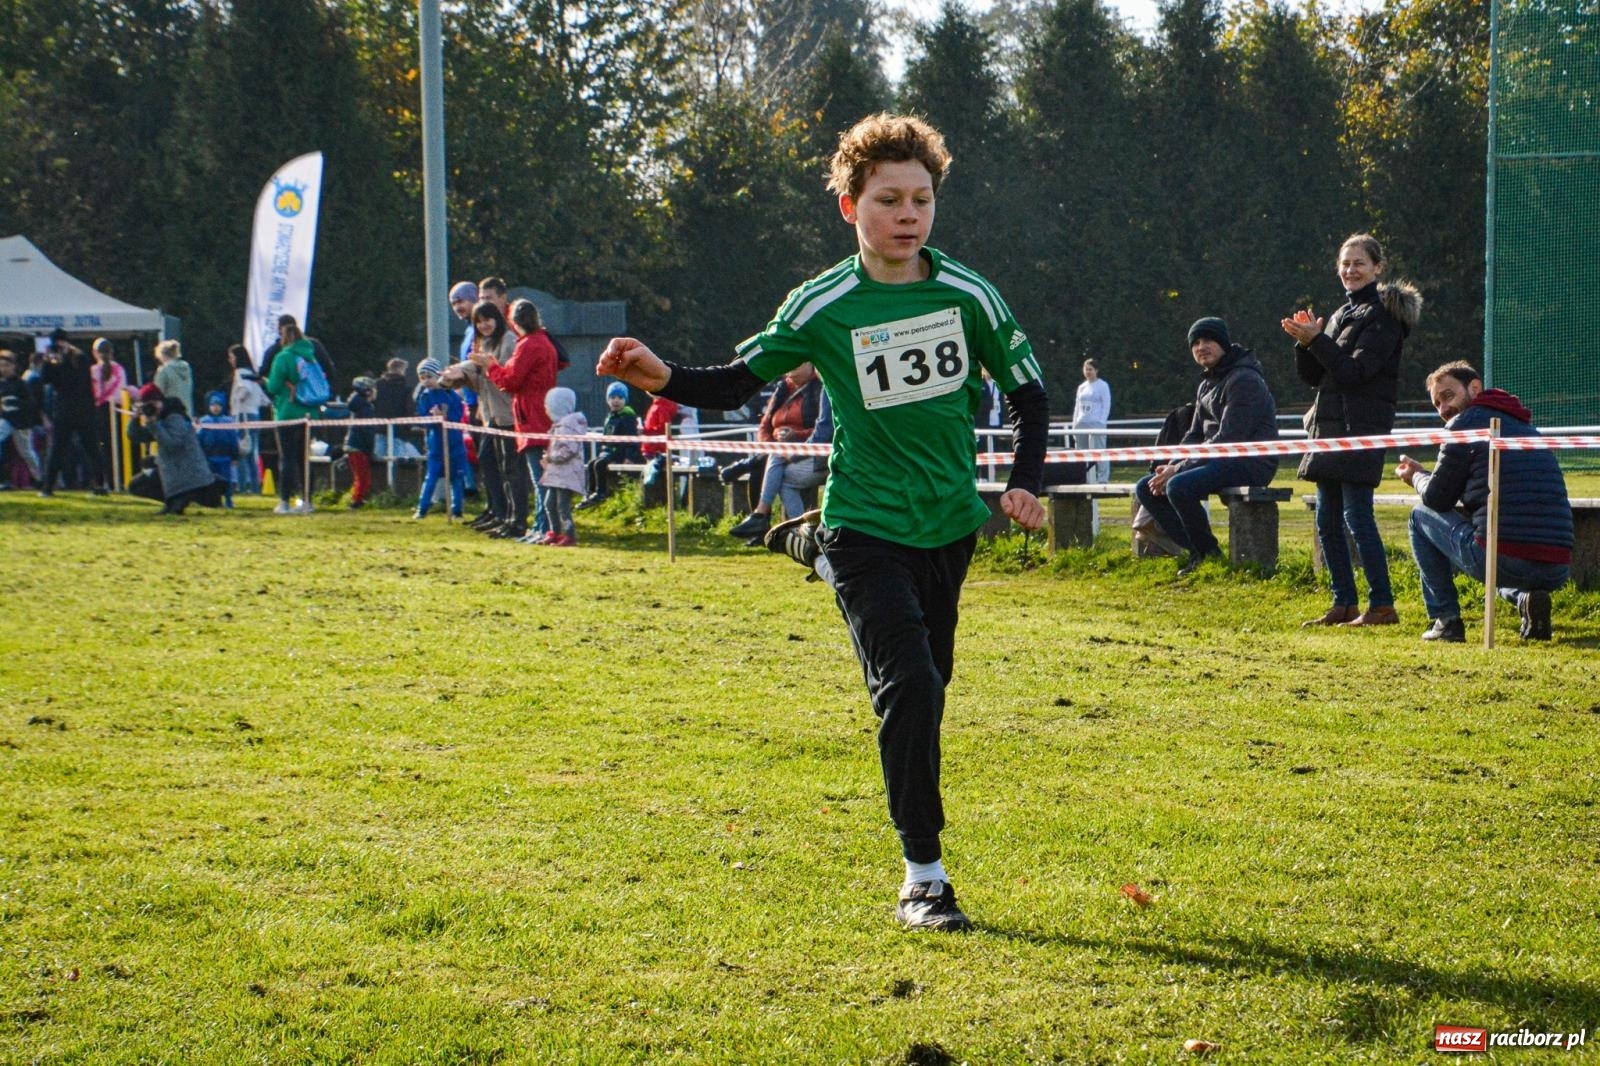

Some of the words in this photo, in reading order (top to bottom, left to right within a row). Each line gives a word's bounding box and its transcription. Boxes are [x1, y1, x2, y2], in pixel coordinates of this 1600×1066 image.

[74, 314, 101, 327] JUTRA
[894, 318, 956, 337] www.personalbest.pl
[1010, 334, 1027, 350] adidas
[866, 340, 963, 392] 138
